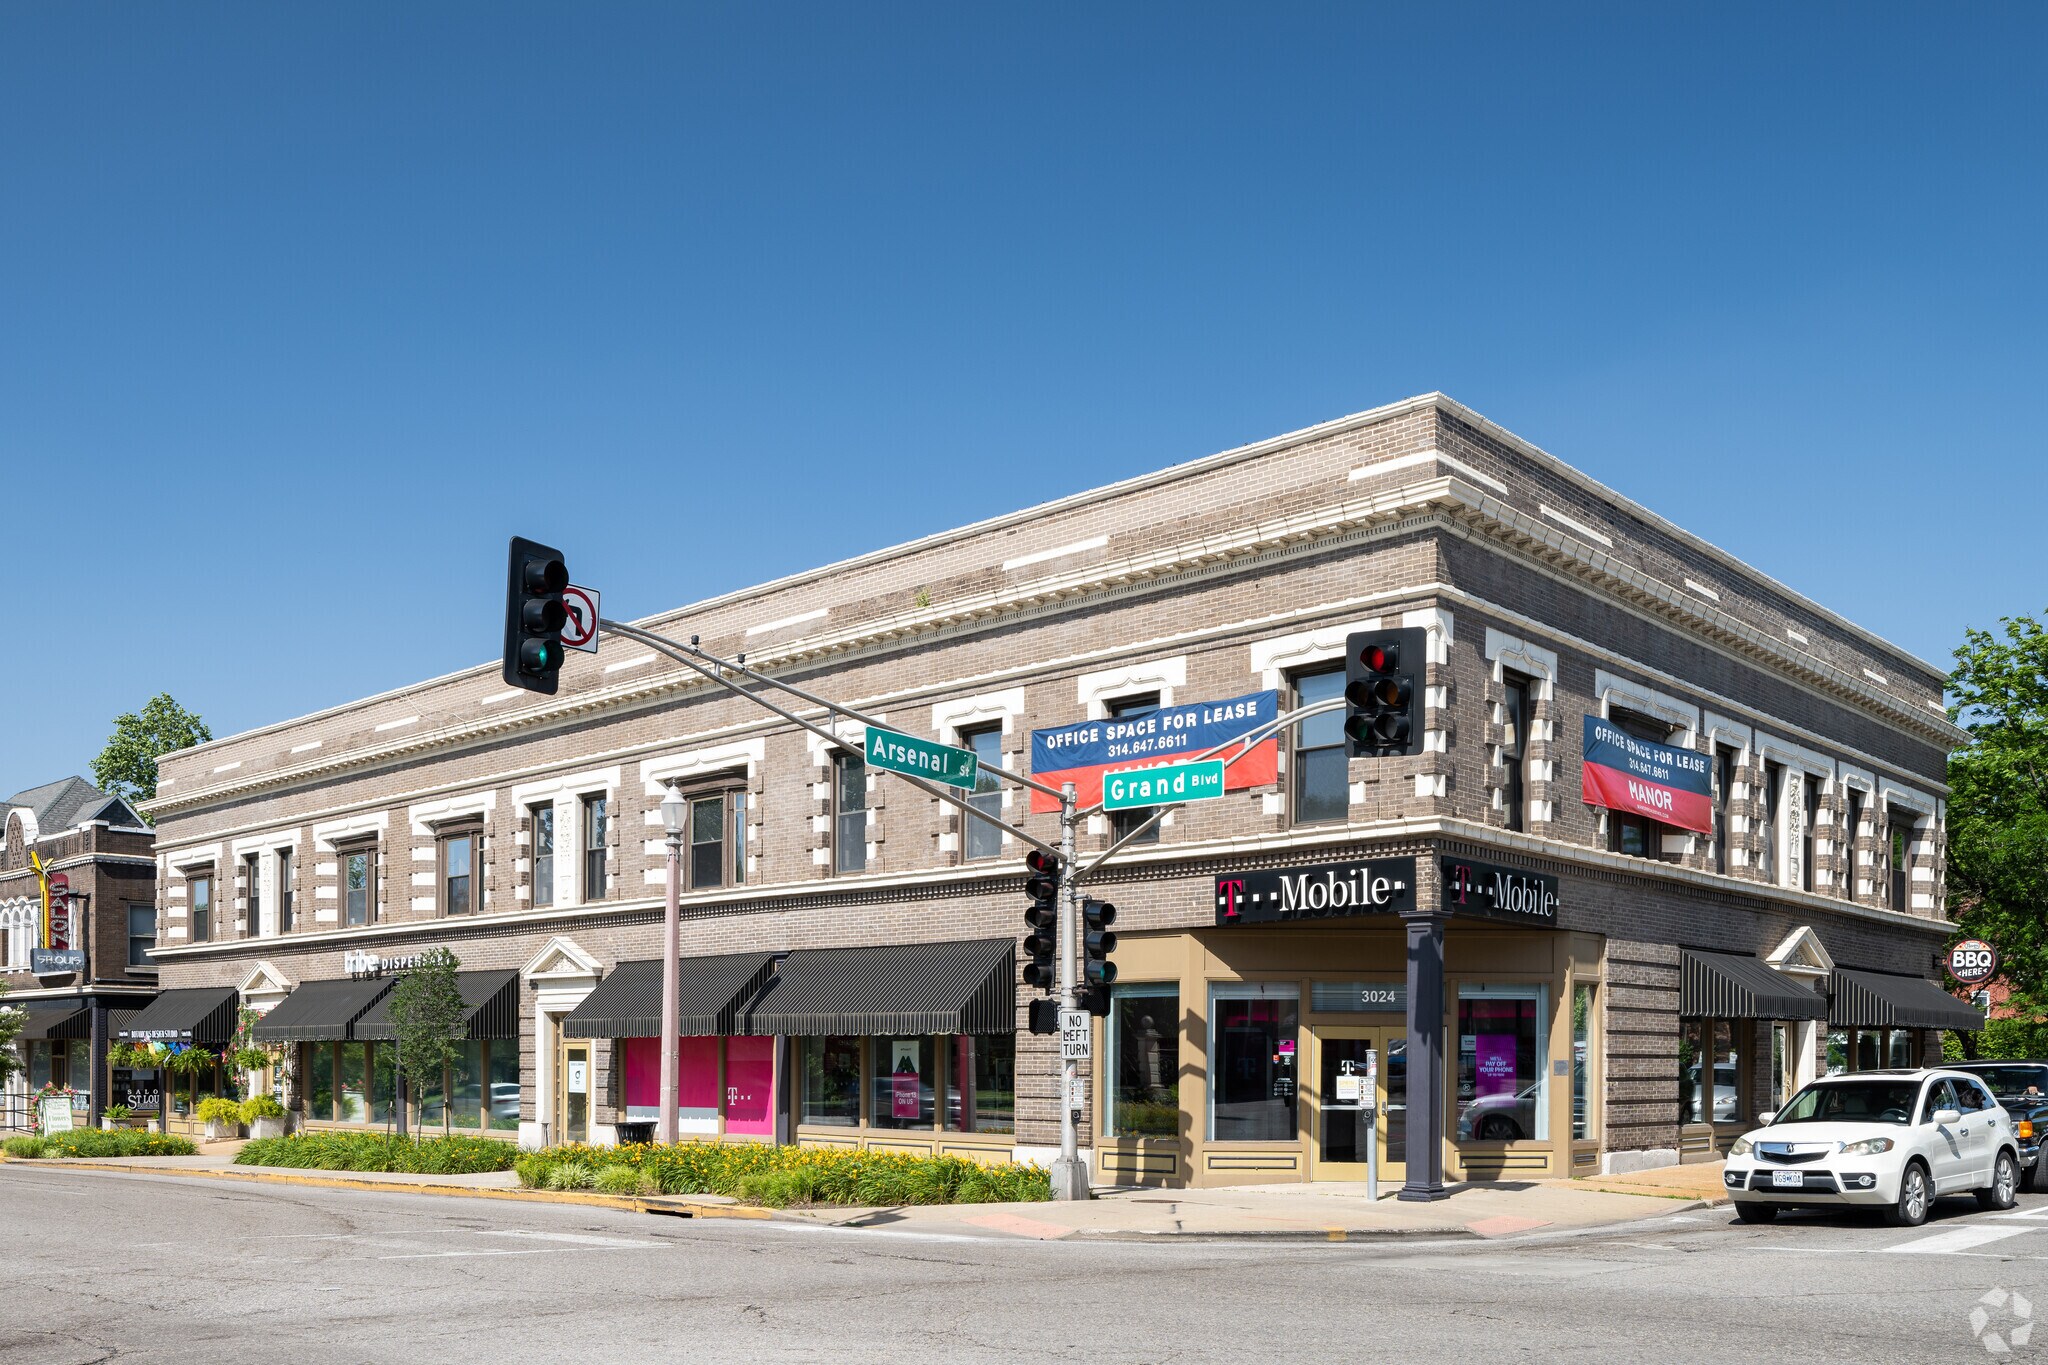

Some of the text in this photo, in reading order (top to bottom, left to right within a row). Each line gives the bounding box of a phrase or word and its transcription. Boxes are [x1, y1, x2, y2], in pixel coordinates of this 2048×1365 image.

[1047, 701, 1257, 749] OFFICE SPACE FOR LEASE
[872, 735, 970, 777] Arsenal St
[1108, 733, 1187, 757] 314.647.6611
[1595, 726, 1705, 773] OFFICE SPACE FOR LEASE
[1628, 757, 1669, 780] 314.647.6611
[1111, 772, 1218, 800] Grand Blvd
[1628, 780, 1673, 811] MANOR
[1279, 868, 1390, 912] Mobile
[1493, 872, 1554, 917] Mobile
[49, 882, 69, 947] SALON
[345, 949, 450, 974] tribe DISPENR
[1952, 951, 1992, 967] BBQ
[1962, 967, 1983, 977] HERE
[1361, 990, 1396, 1003] 3024
[1069, 1015, 1082, 1028] NO
[1063, 1029, 1088, 1042] LEFT
[1063, 1043, 1088, 1056] TURN
[143, 1095, 160, 1104] LOU
